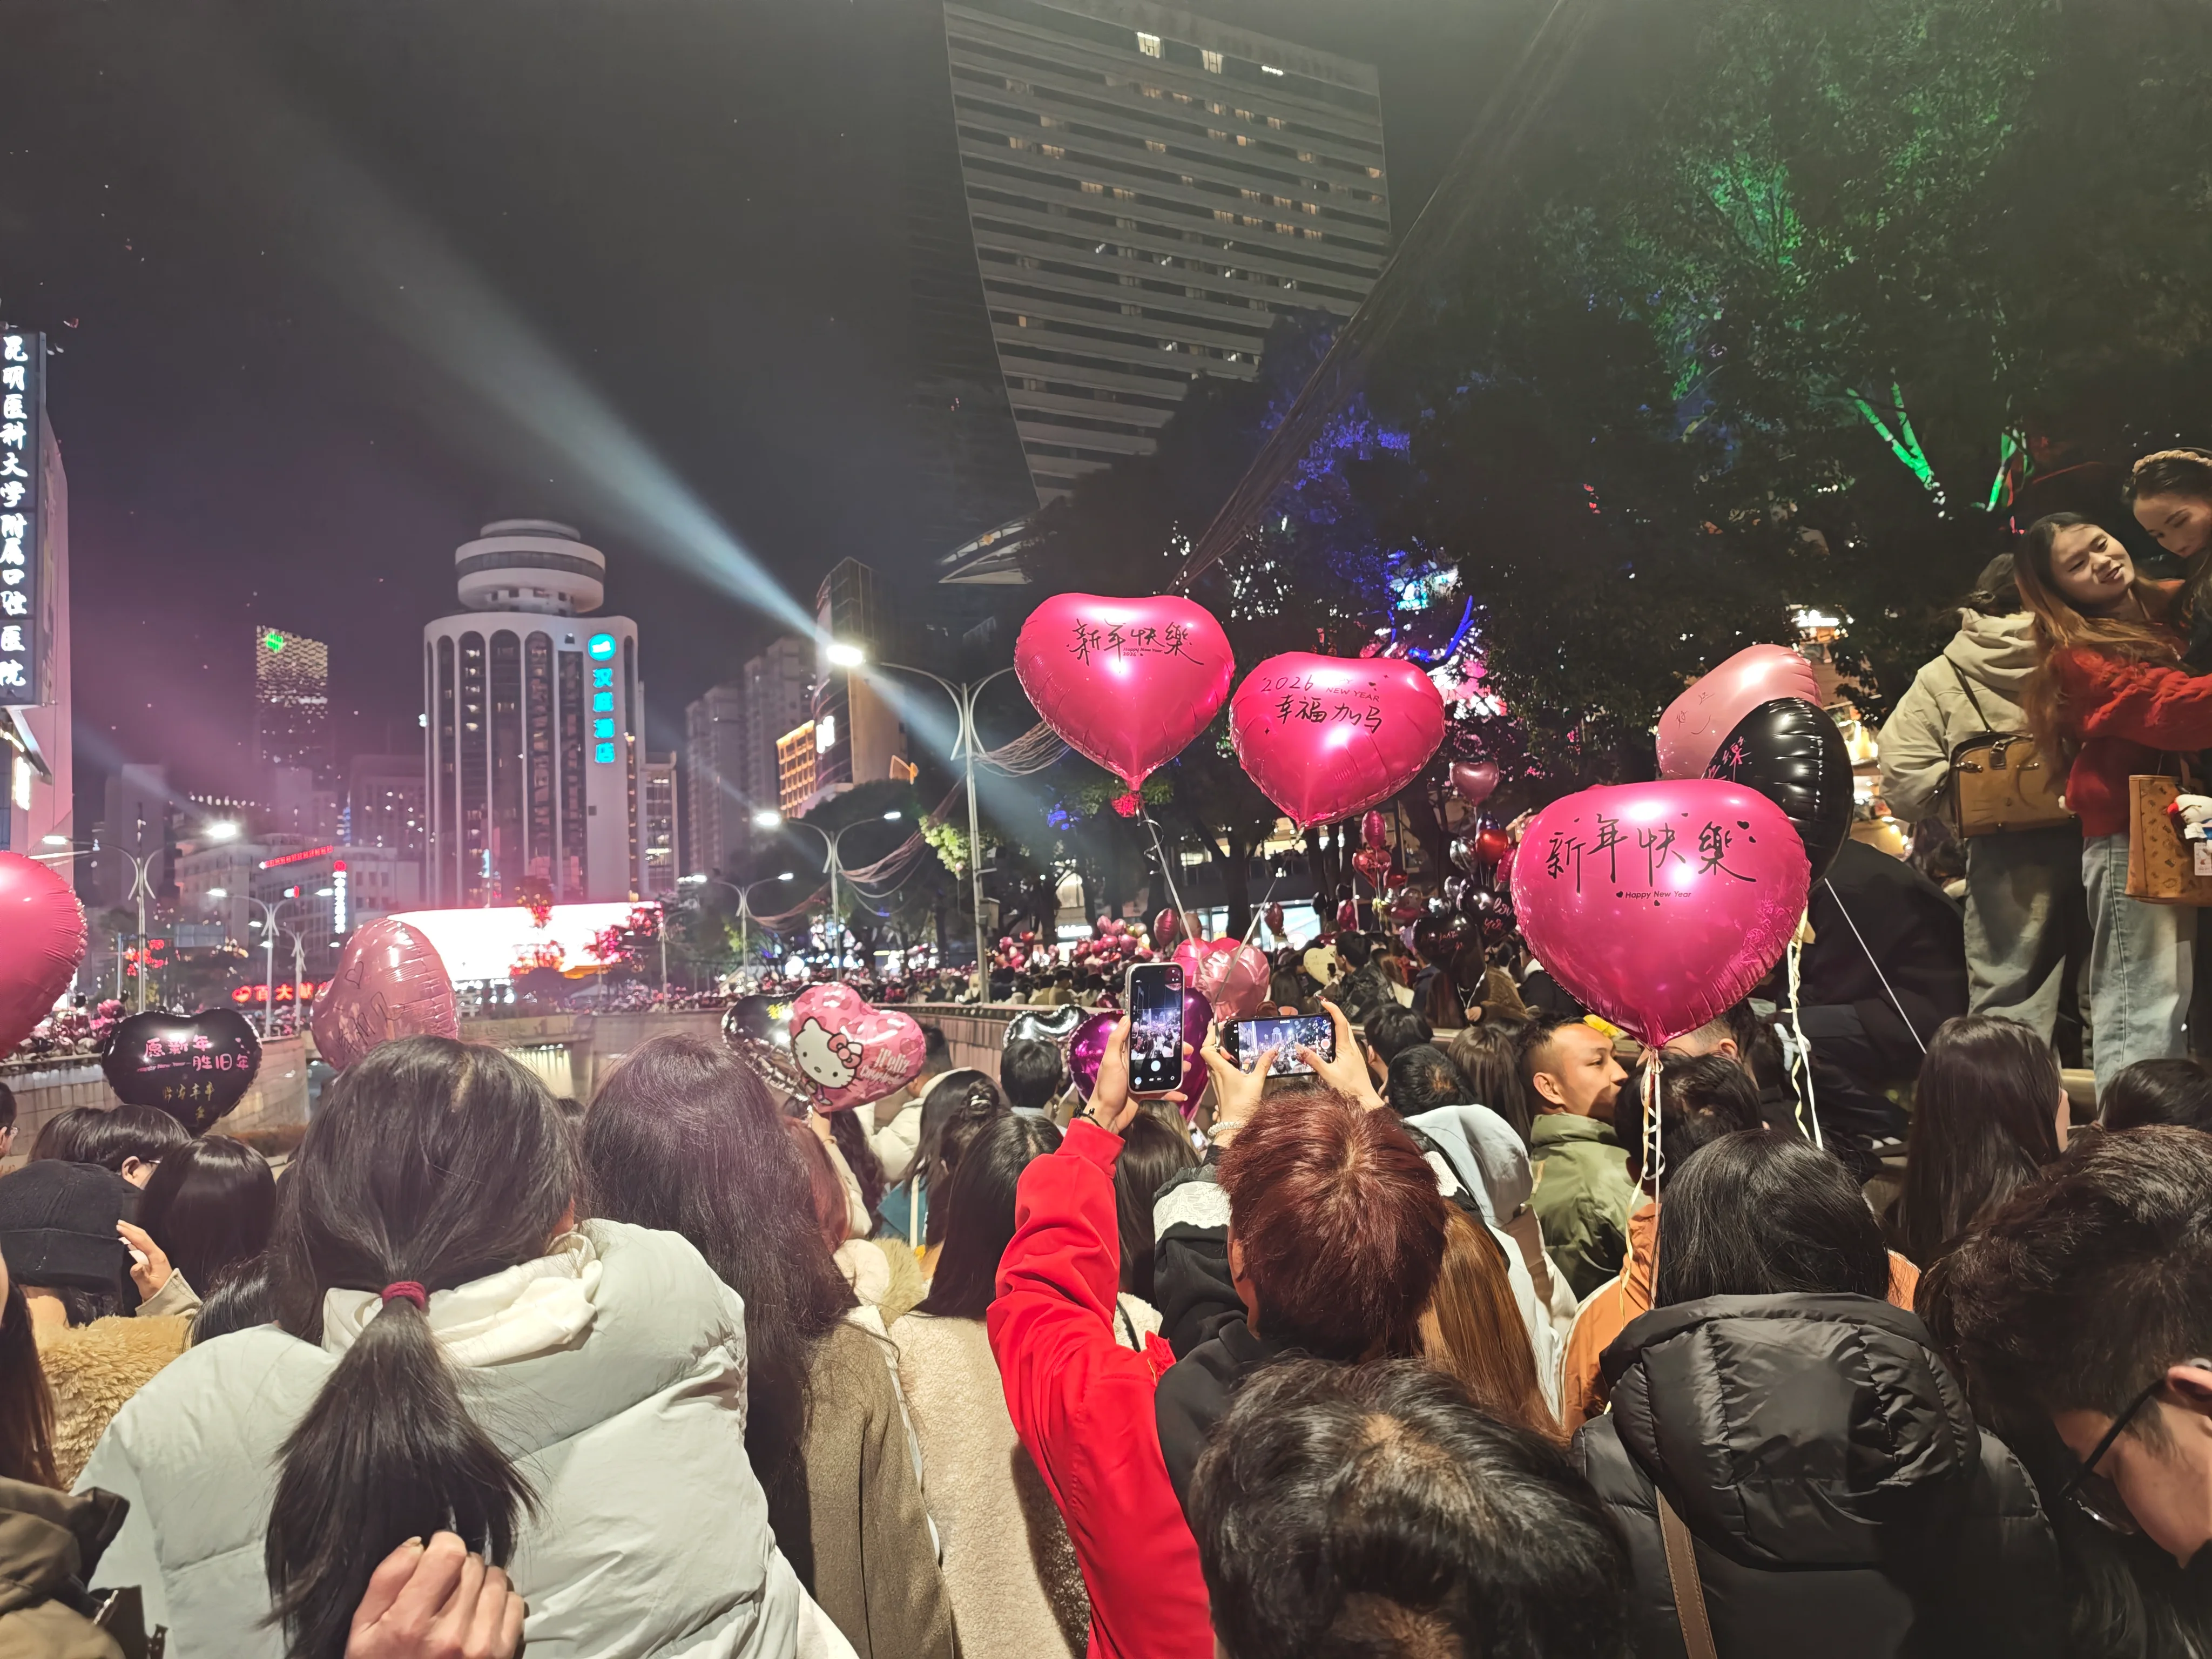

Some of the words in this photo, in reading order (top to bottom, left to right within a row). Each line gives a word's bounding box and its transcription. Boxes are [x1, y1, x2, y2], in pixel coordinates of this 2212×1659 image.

[0, 335, 28, 687] 昆明医科大学附属口腔医院
[1261, 675, 1313, 692] 2026
[1326, 687, 1350, 695] NEW
[1354, 690, 1380, 702] YEAR
[1546, 813, 1757, 894] 新年快樂
[1626, 891, 1651, 899] Happy
